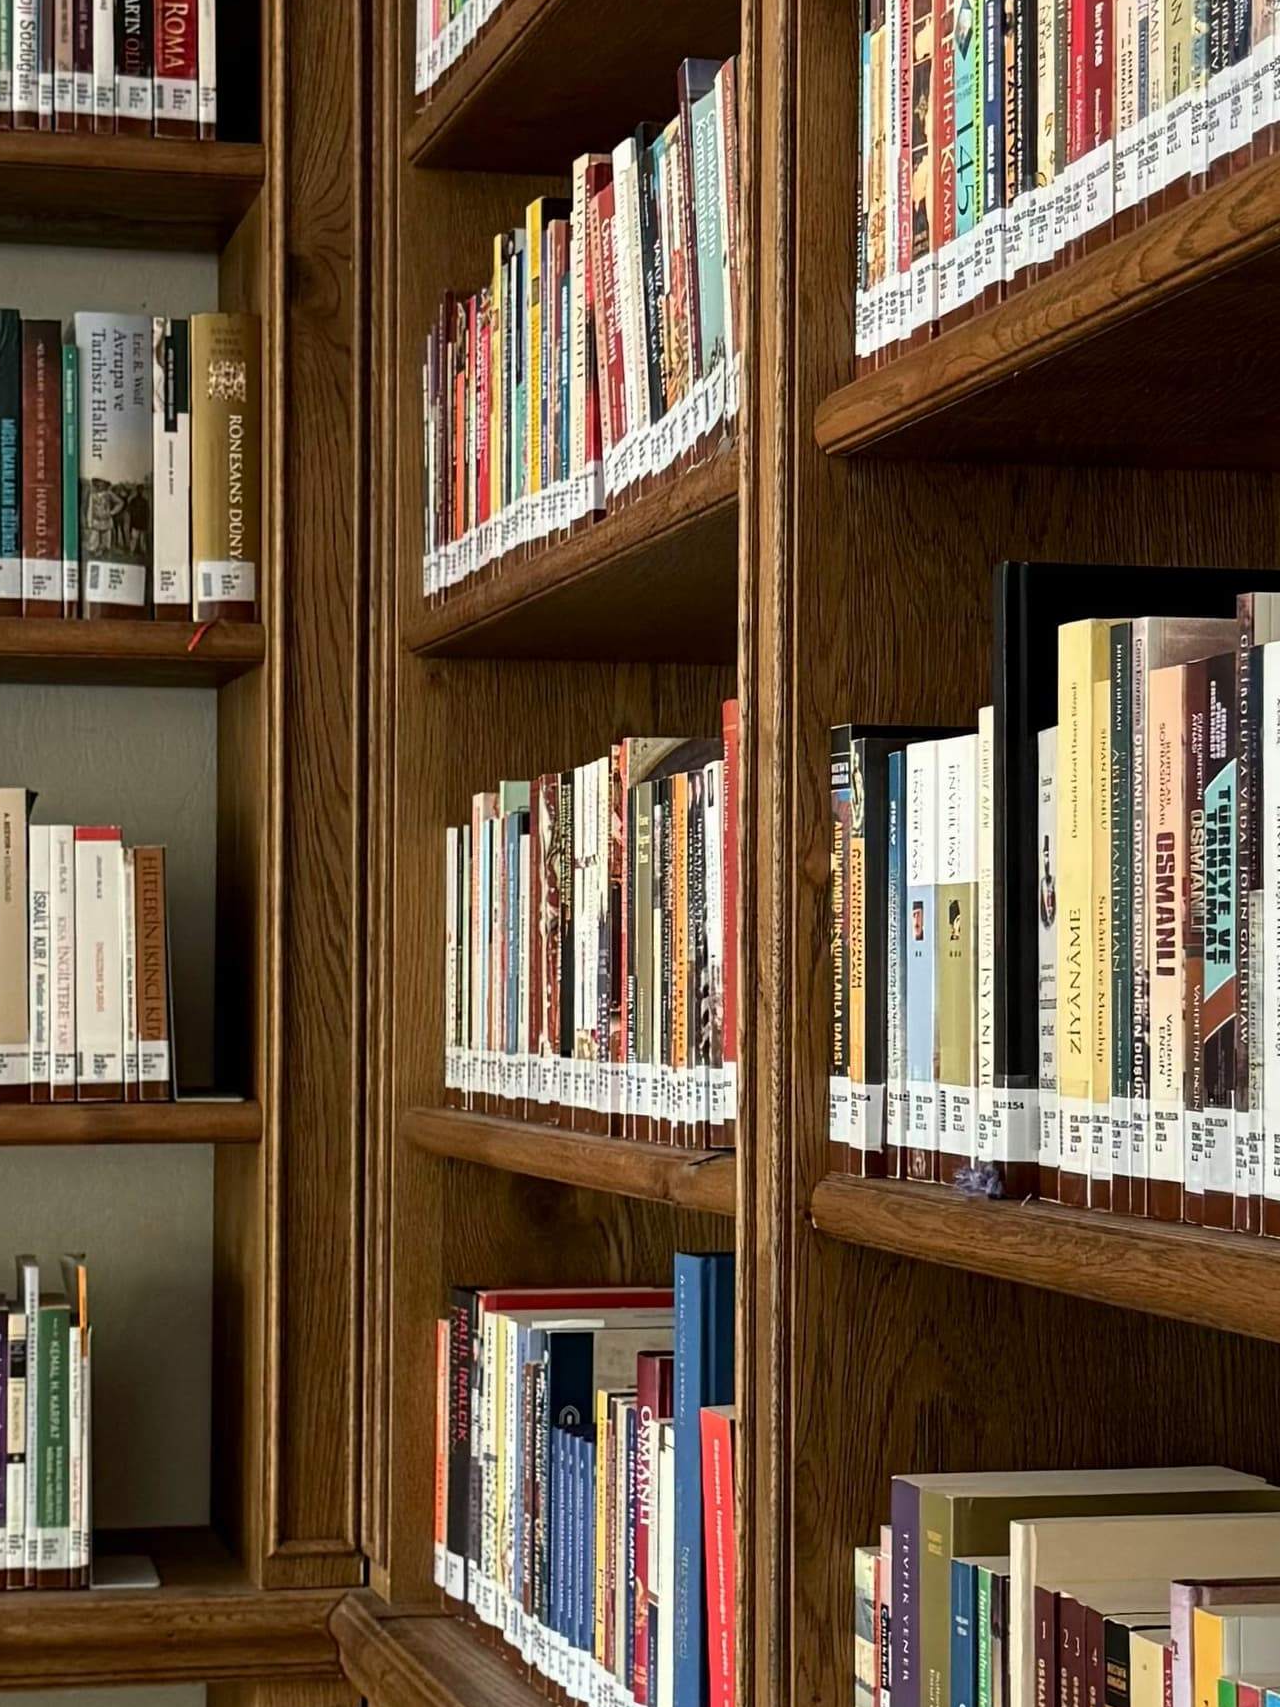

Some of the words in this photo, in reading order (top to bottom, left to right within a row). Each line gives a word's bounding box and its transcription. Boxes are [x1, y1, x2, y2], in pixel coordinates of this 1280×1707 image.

[91, 328, 106, 395] Tarihsiz
[91, 398, 106, 461] Halklar
[1154, 831, 1176, 977] OSMANLI
[456, 1366, 469, 1441] İNALCIK
[639, 1404, 656, 1527] OSMANLI
